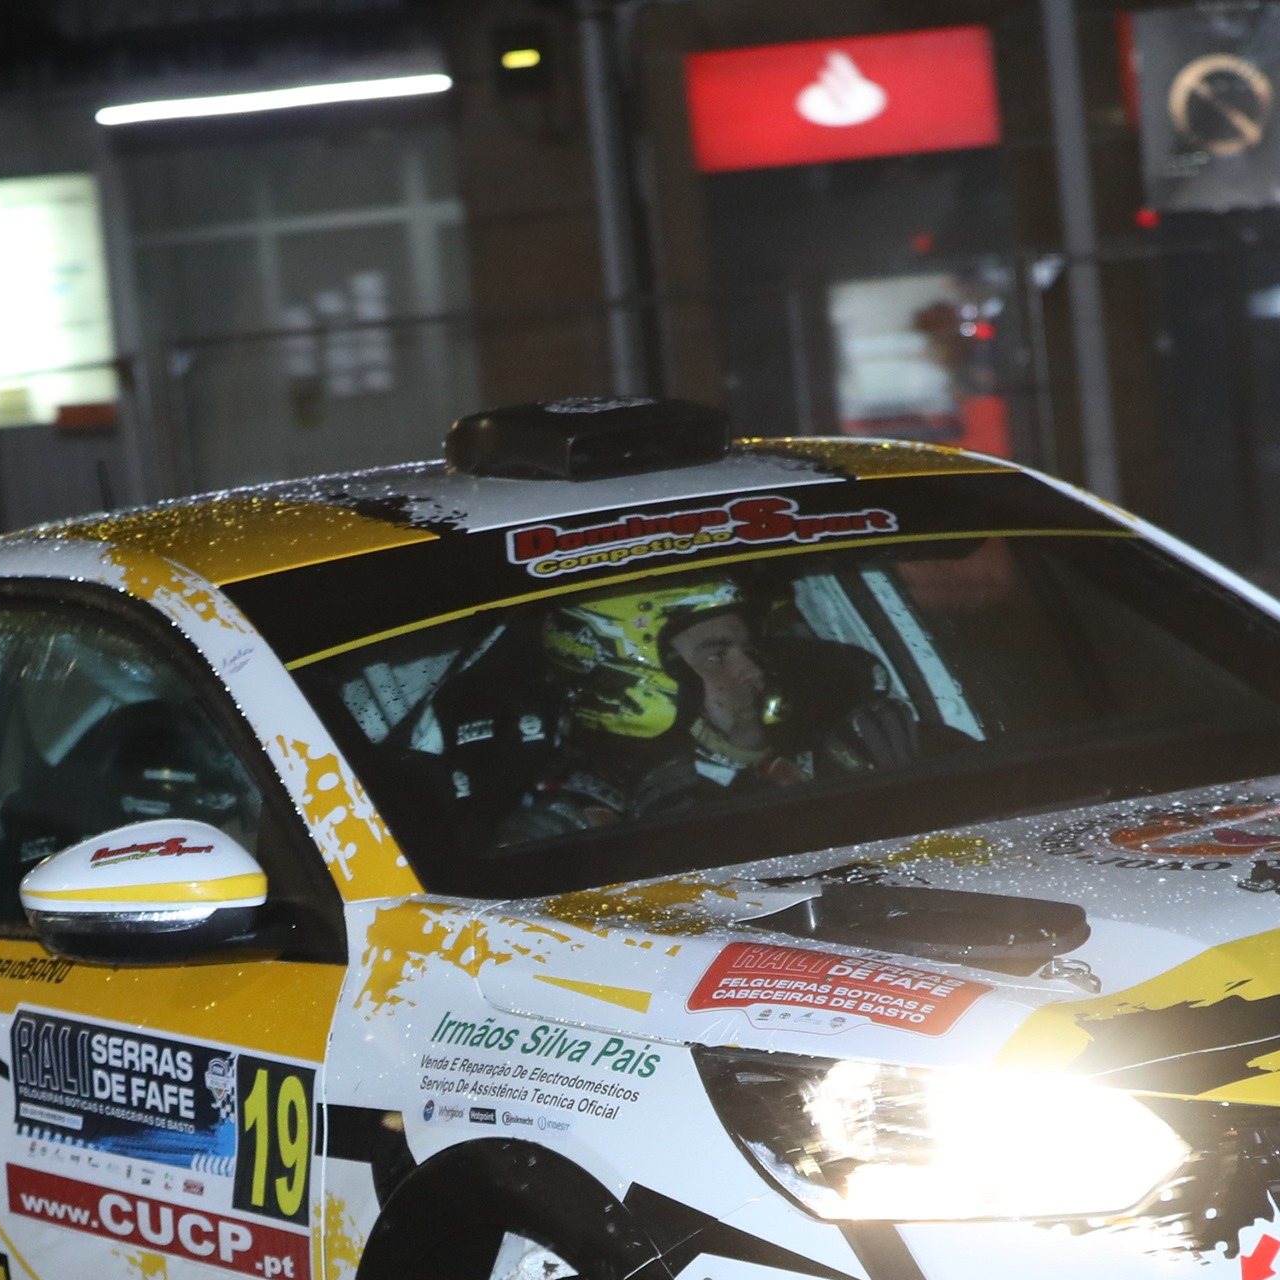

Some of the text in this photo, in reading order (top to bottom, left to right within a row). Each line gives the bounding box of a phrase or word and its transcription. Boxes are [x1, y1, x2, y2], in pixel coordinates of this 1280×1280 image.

[534, 531, 732, 575] Competição
[718, 976, 937, 1015] FELGUEIRAS BOTICAS E
[827, 963, 956, 999] DE FAFE
[838, 957, 966, 990] SERRAS
[711, 988, 926, 1024] CABECEIRAS DE BASTO
[17, 1016, 92, 1099] RALI
[91, 1032, 194, 1083] SERRAS
[431, 1011, 661, 1079] Irmãos Silva Pais
[93, 1068, 128, 1106] DE
[130, 1075, 196, 1120] FAFE
[420, 1053, 640, 1103] Venda E Reparação De Electrodomésticos
[420, 1075, 620, 1121] Serviço De Assistência Tecnica Oficial
[154, 1115, 167, 1128] DE
[167, 1118, 196, 1135] BASTO
[243, 1067, 309, 1217] 19
